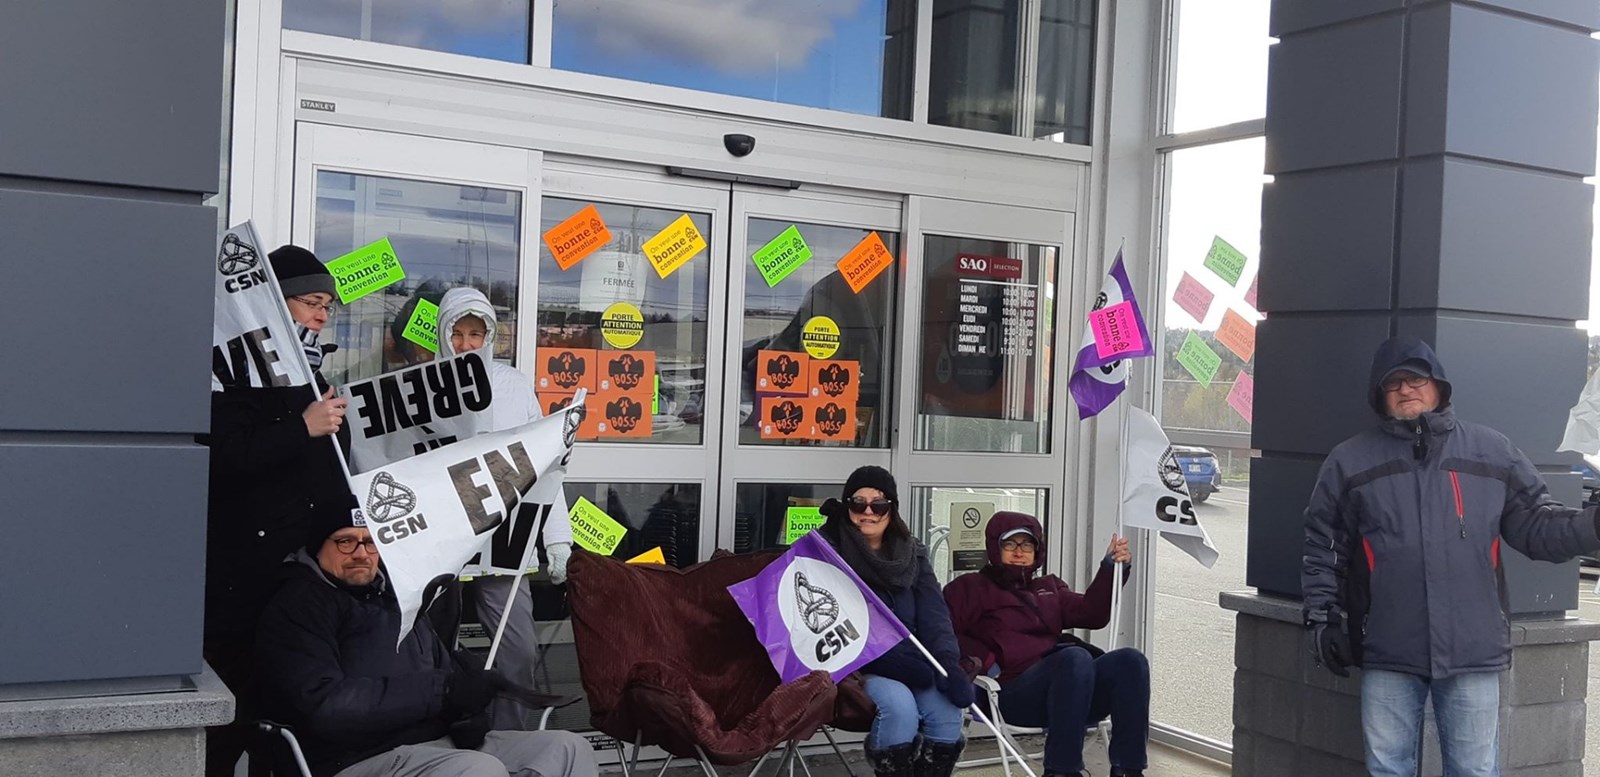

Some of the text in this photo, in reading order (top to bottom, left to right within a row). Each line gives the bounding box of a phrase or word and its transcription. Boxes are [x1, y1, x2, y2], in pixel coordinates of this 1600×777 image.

[302, 101, 334, 110] STANLEY
[554, 228, 590, 254] bonne
[562, 236, 598, 262] convention
[653, 238, 686, 264] bonne
[334, 254, 376, 275] On veut une
[660, 244, 694, 270] convention
[762, 248, 793, 273] bonne
[768, 254, 800, 280] convention
[847, 254, 876, 280] bonne
[960, 257, 987, 272] SAQ
[225, 269, 268, 294] CSN
[336, 264, 380, 286] bonne
[343, 272, 388, 295] convention
[603, 277, 635, 288] FERMÉE
[854, 260, 882, 286] convention
[960, 284, 978, 293] LUNDI
[960, 294, 978, 303] MARDI
[421, 308, 431, 318] On
[612, 313, 634, 321] PORTE
[960, 304, 988, 314] MERCREDI
[963, 314, 976, 322] EUDI
[410, 327, 438, 345] conven
[960, 324, 986, 334] VENDREDI
[1106, 309, 1121, 342] bonne
[804, 333, 838, 341] ATTENTION
[959, 334, 980, 342] SAMEDI
[350, 353, 492, 439] GRÈVE
[447, 441, 537, 536] EN
[578, 506, 586, 515] On
[1156, 496, 1198, 526] CS
[377, 513, 428, 544] CSN
[570, 511, 604, 540] bonne
[790, 520, 821, 530] bonn
[815, 618, 860, 662] CSN
